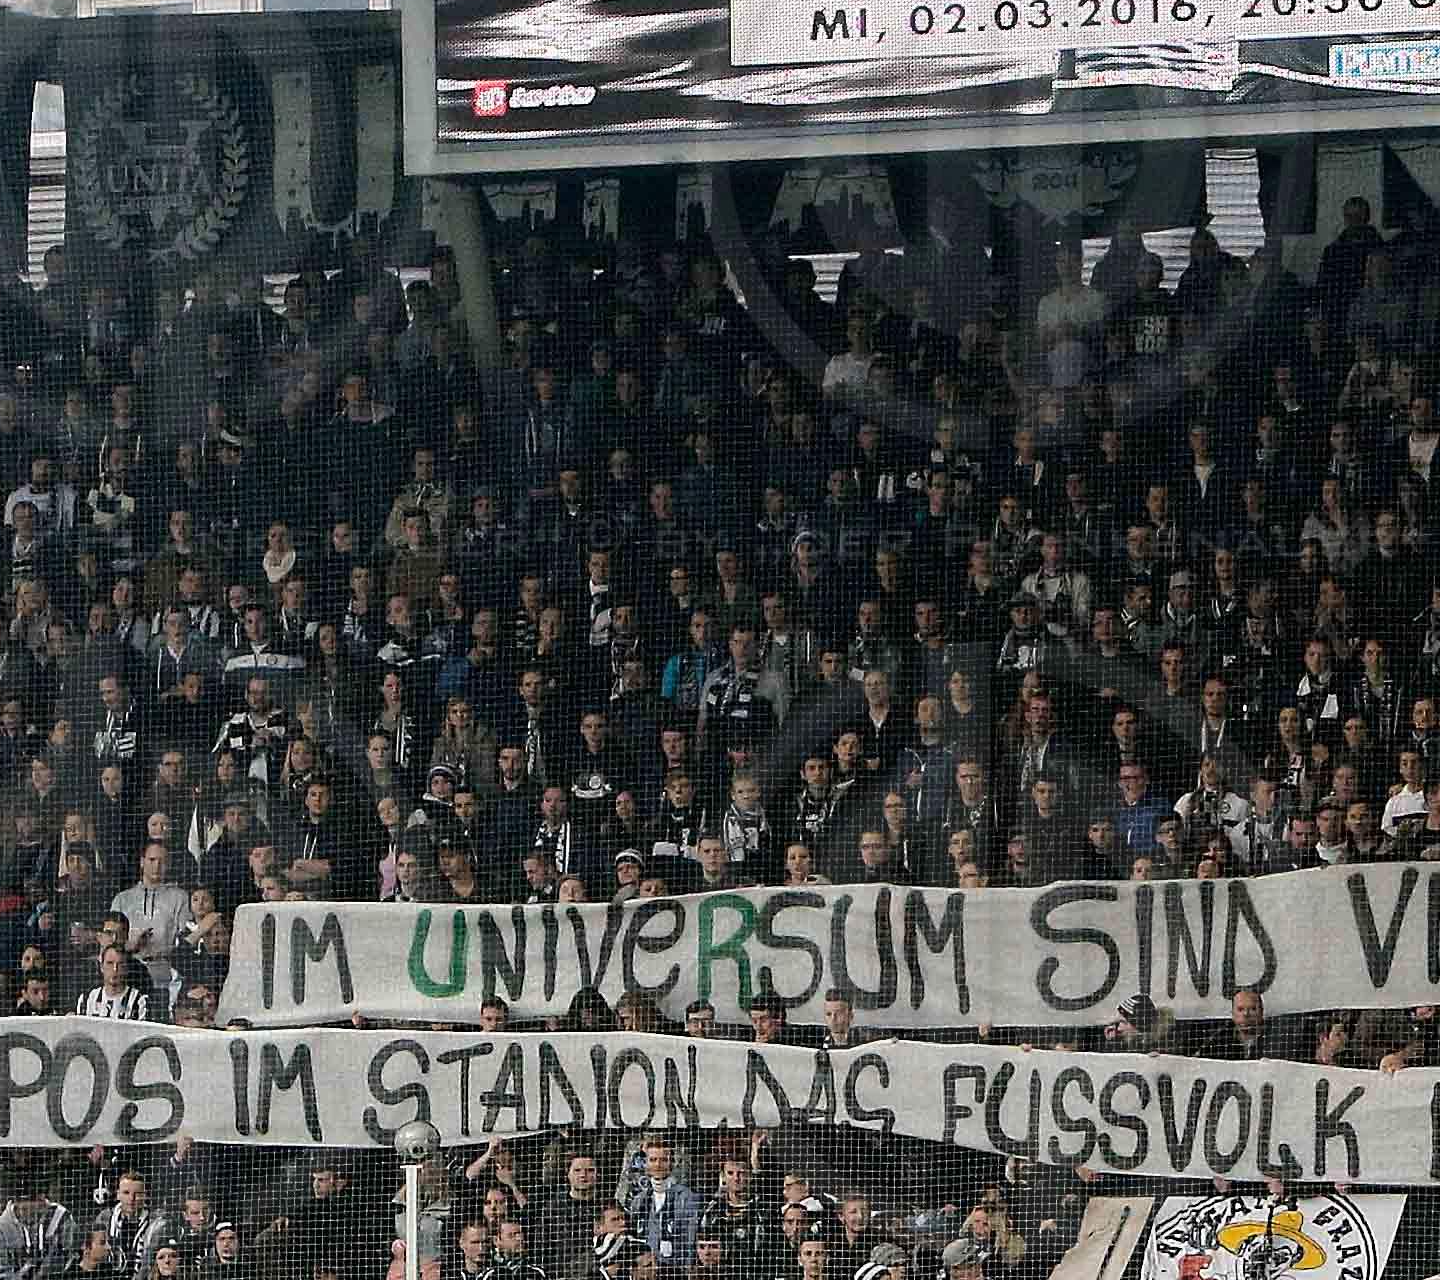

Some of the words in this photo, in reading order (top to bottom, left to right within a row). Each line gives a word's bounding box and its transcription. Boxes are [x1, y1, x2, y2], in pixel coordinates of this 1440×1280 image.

[809, 8, 887, 43] MI,
[262, 909, 355, 1009] IM
[1030, 878, 1278, 1013] SIND
[229, 1037, 322, 1143] IM
[942, 1060, 1365, 1180] FUSSVOLK
